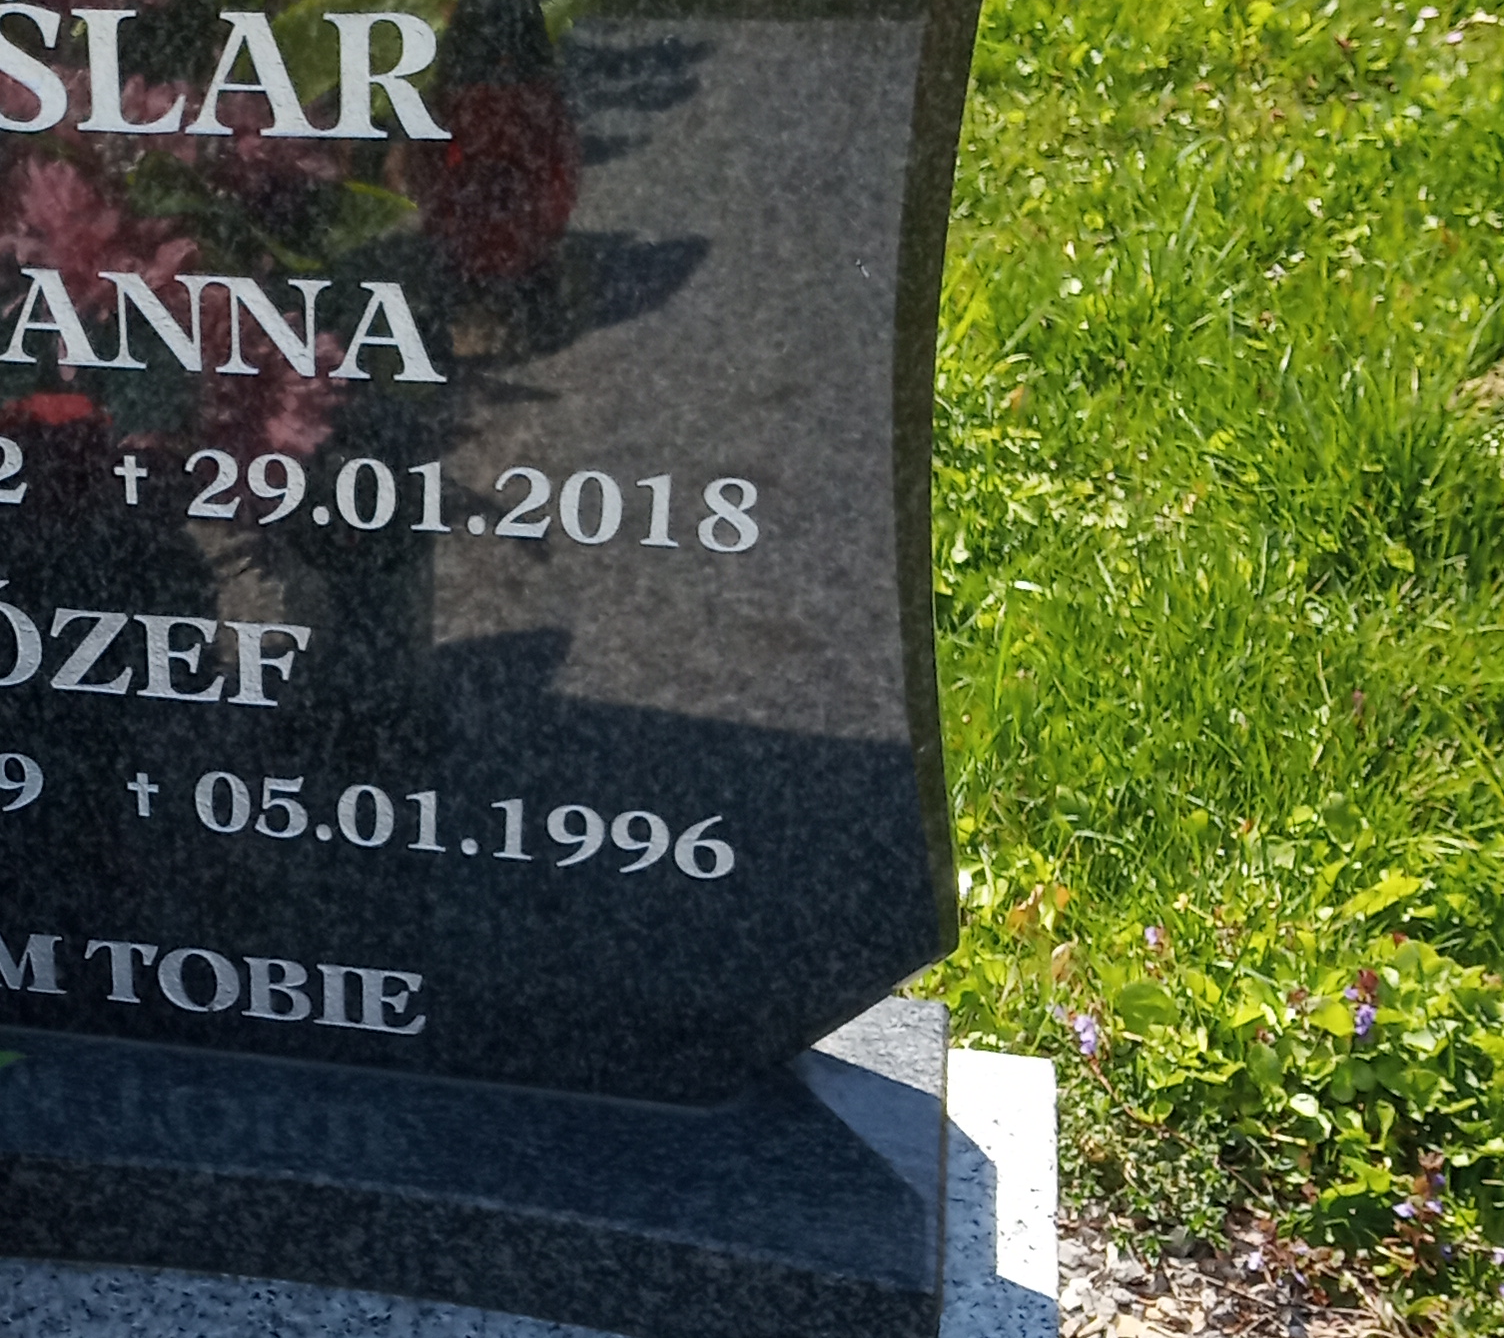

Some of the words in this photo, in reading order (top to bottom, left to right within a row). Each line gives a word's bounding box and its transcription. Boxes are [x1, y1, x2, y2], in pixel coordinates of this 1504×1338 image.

[183, 448, 761, 553] 29.01.2018
[194, 770, 737, 880] 05.01.1996
[83, 940, 428, 1036] TOBIE
